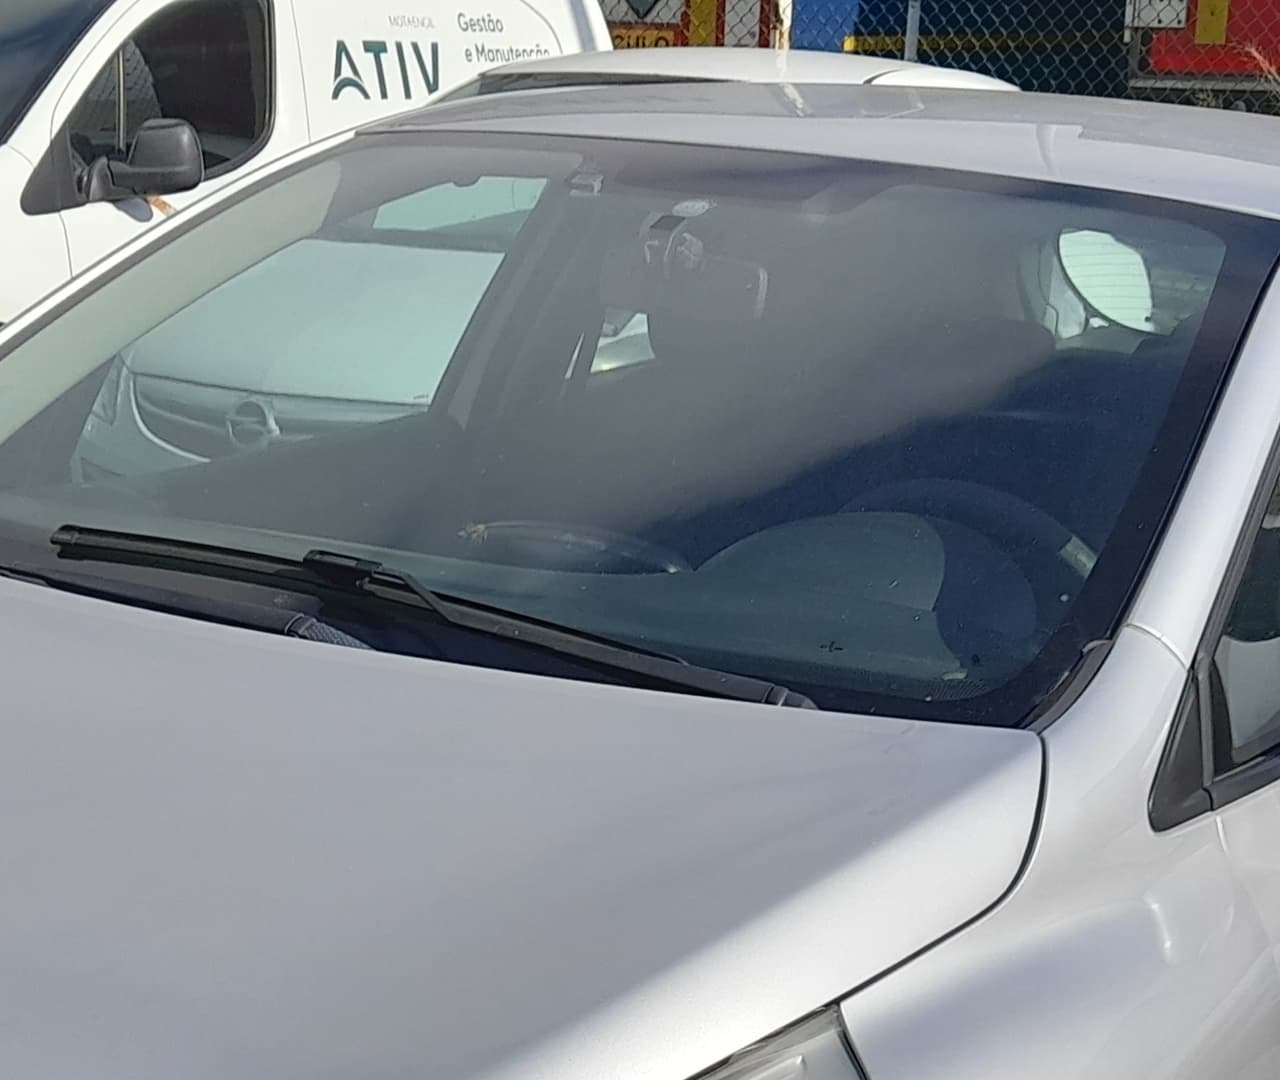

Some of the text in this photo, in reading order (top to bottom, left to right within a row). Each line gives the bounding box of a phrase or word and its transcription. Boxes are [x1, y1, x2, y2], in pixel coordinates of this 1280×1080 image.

[457, 12, 504, 33] Gestão
[464, 48, 473, 63] e
[331, 40, 439, 100] ATIV
